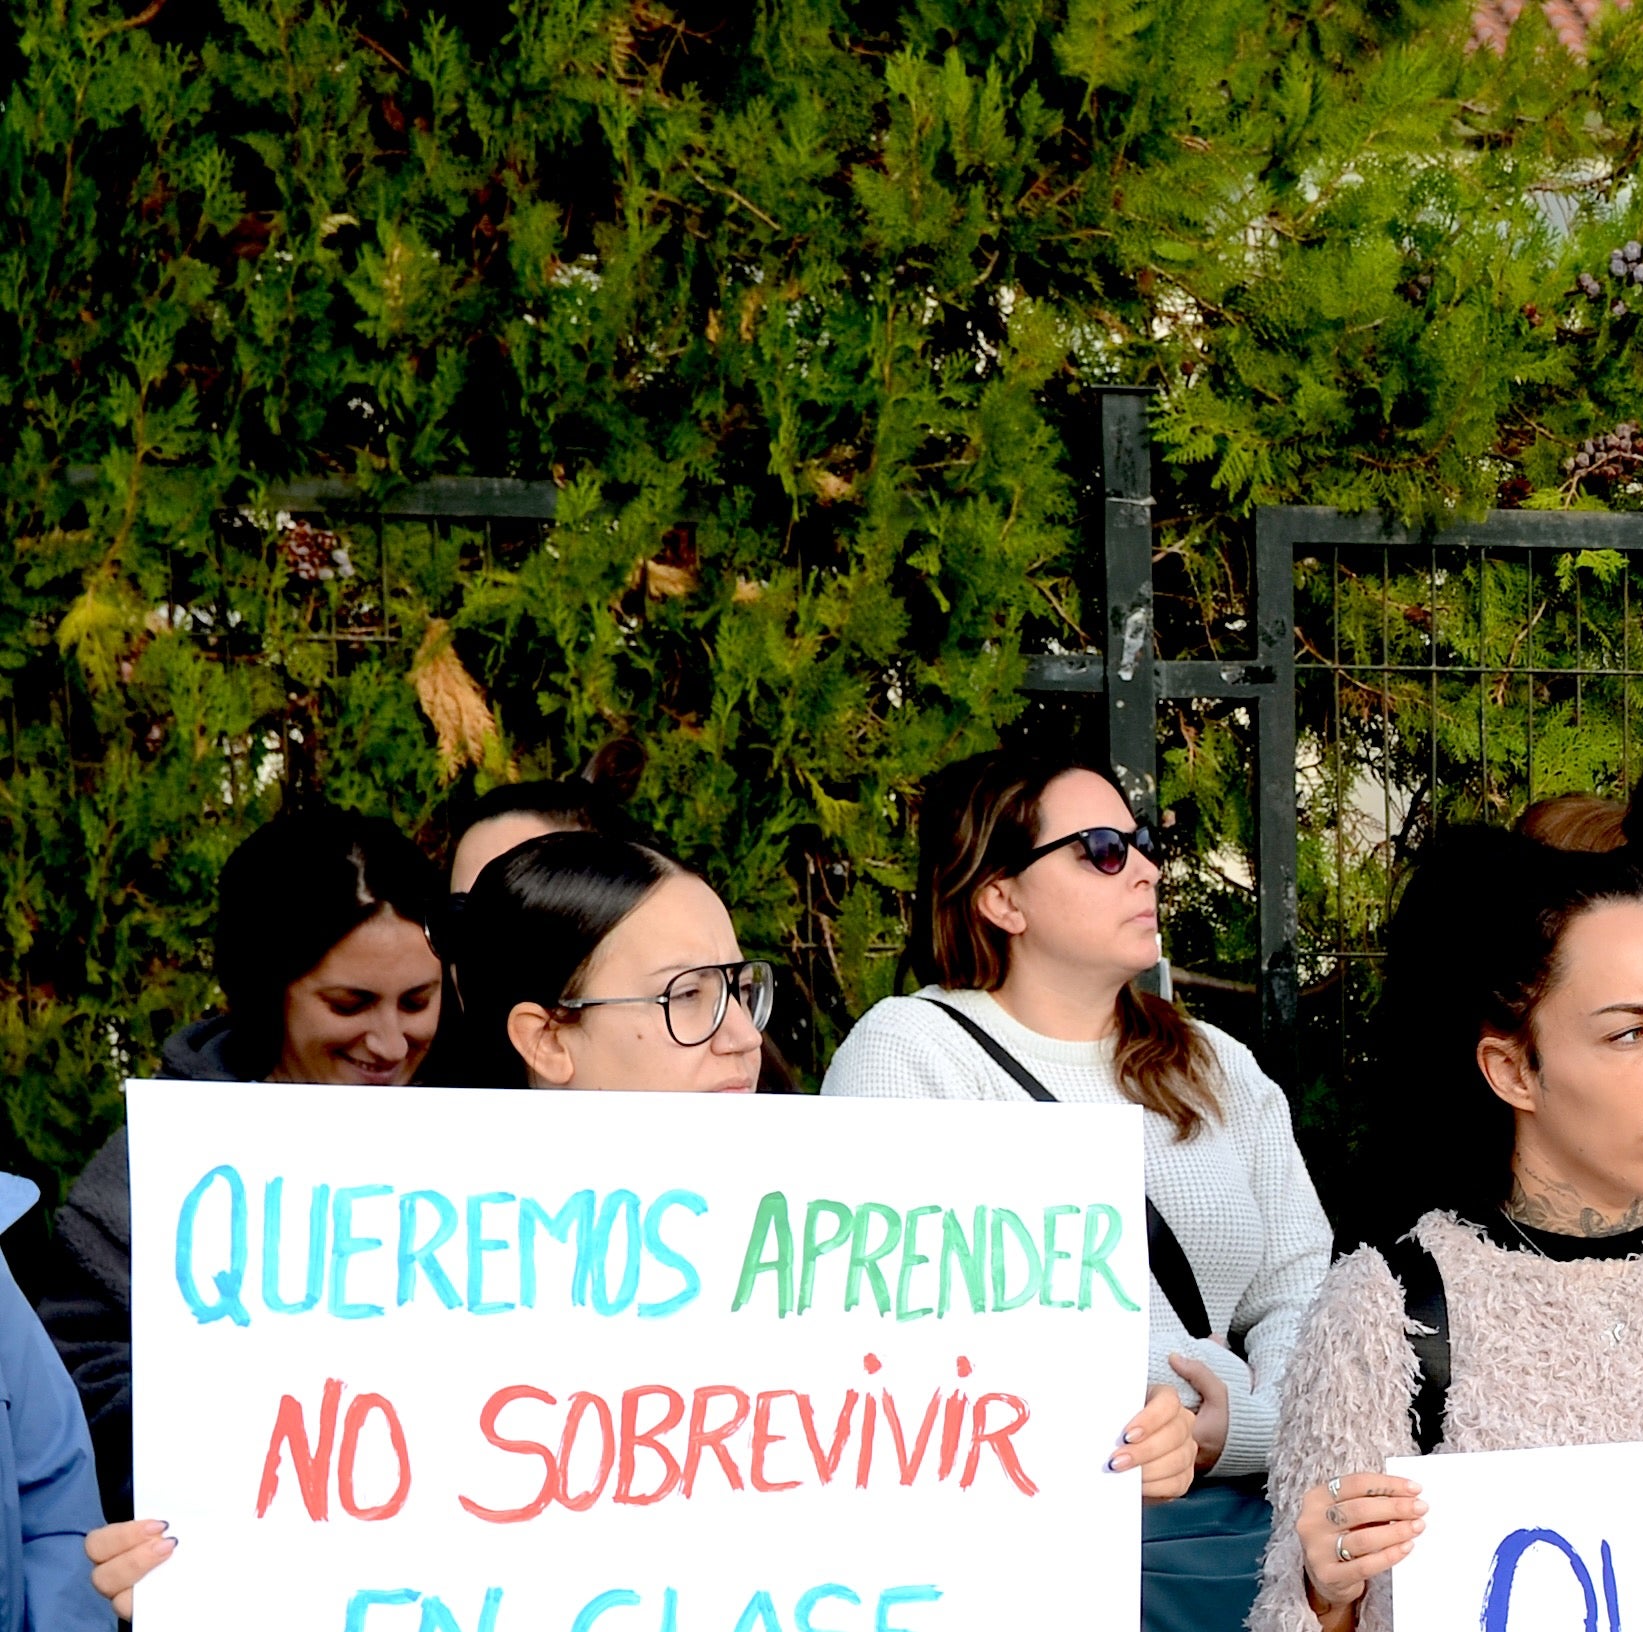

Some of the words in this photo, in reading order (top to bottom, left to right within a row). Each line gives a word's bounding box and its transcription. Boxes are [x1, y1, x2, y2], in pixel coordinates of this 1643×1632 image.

[175, 1164, 708, 1327] QUEREMOS
[732, 1191, 1141, 1321] APRENDER
[256, 1378, 411, 1521] NO
[458, 1353, 1038, 1524] SOBREVIVIR
